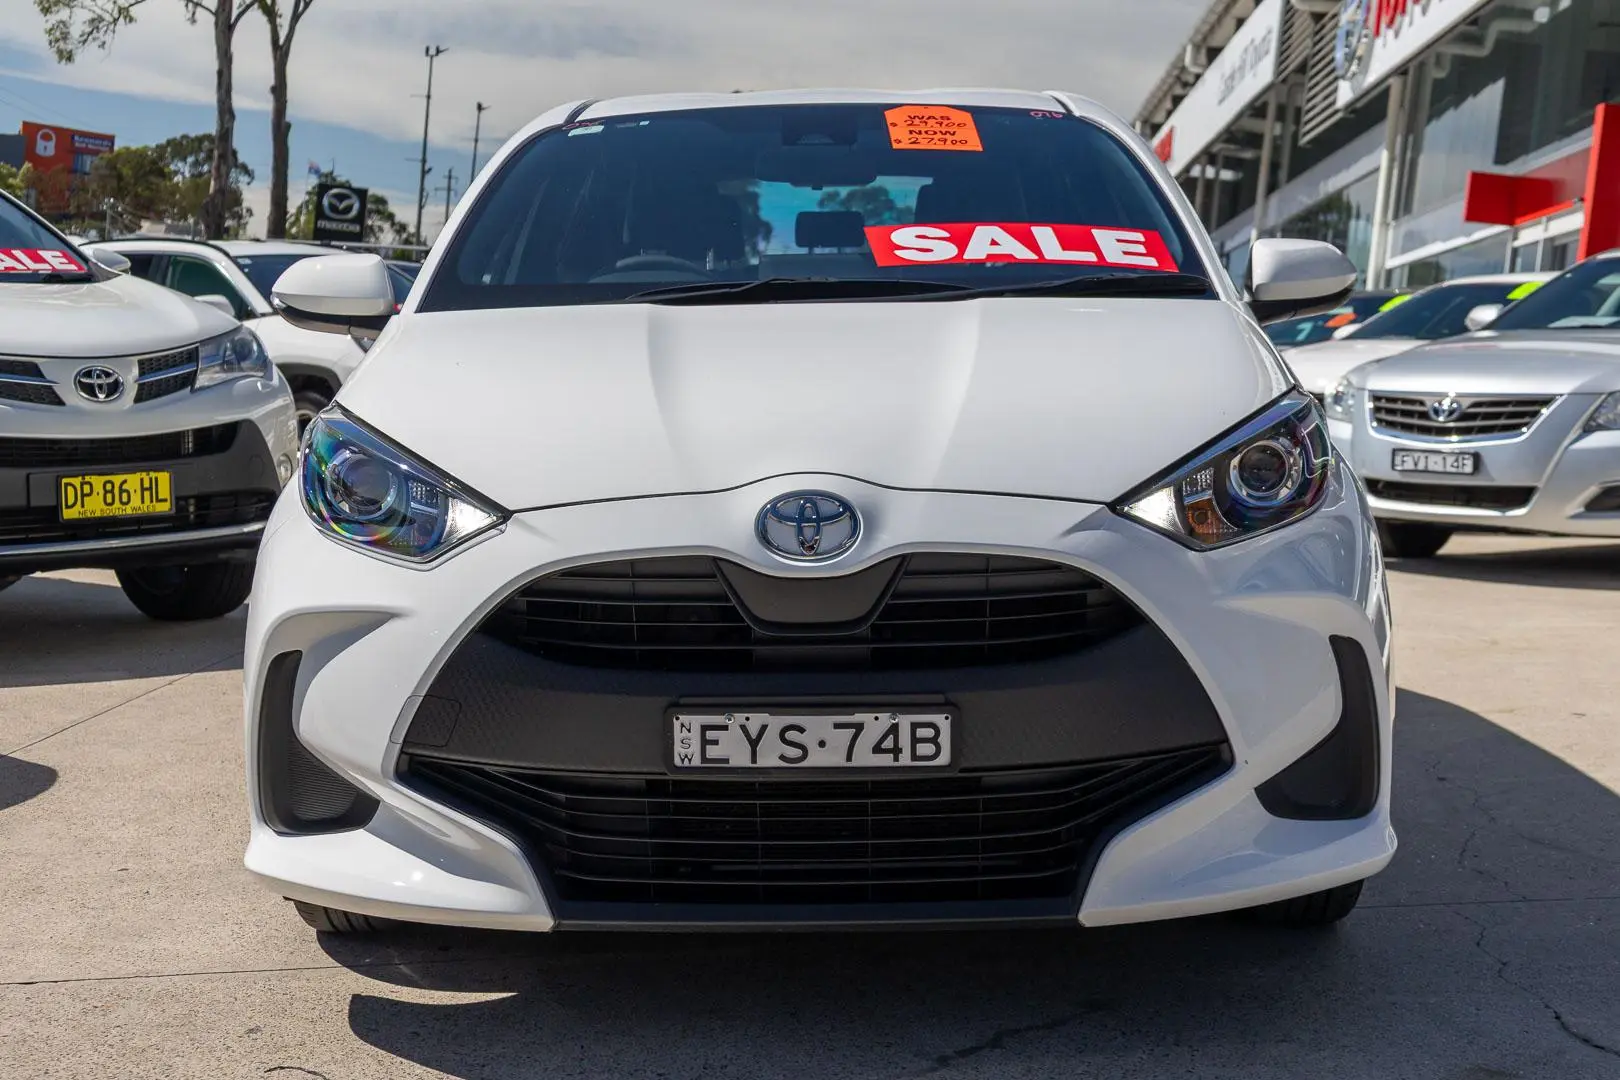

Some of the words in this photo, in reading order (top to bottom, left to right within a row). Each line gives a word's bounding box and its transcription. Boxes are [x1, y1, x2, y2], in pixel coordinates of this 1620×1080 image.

[890, 226, 1159, 267] SALE
[79, 509, 97, 517] NEW
[100, 506, 127, 515] SOUTH
[131, 505, 156, 513] WALES
